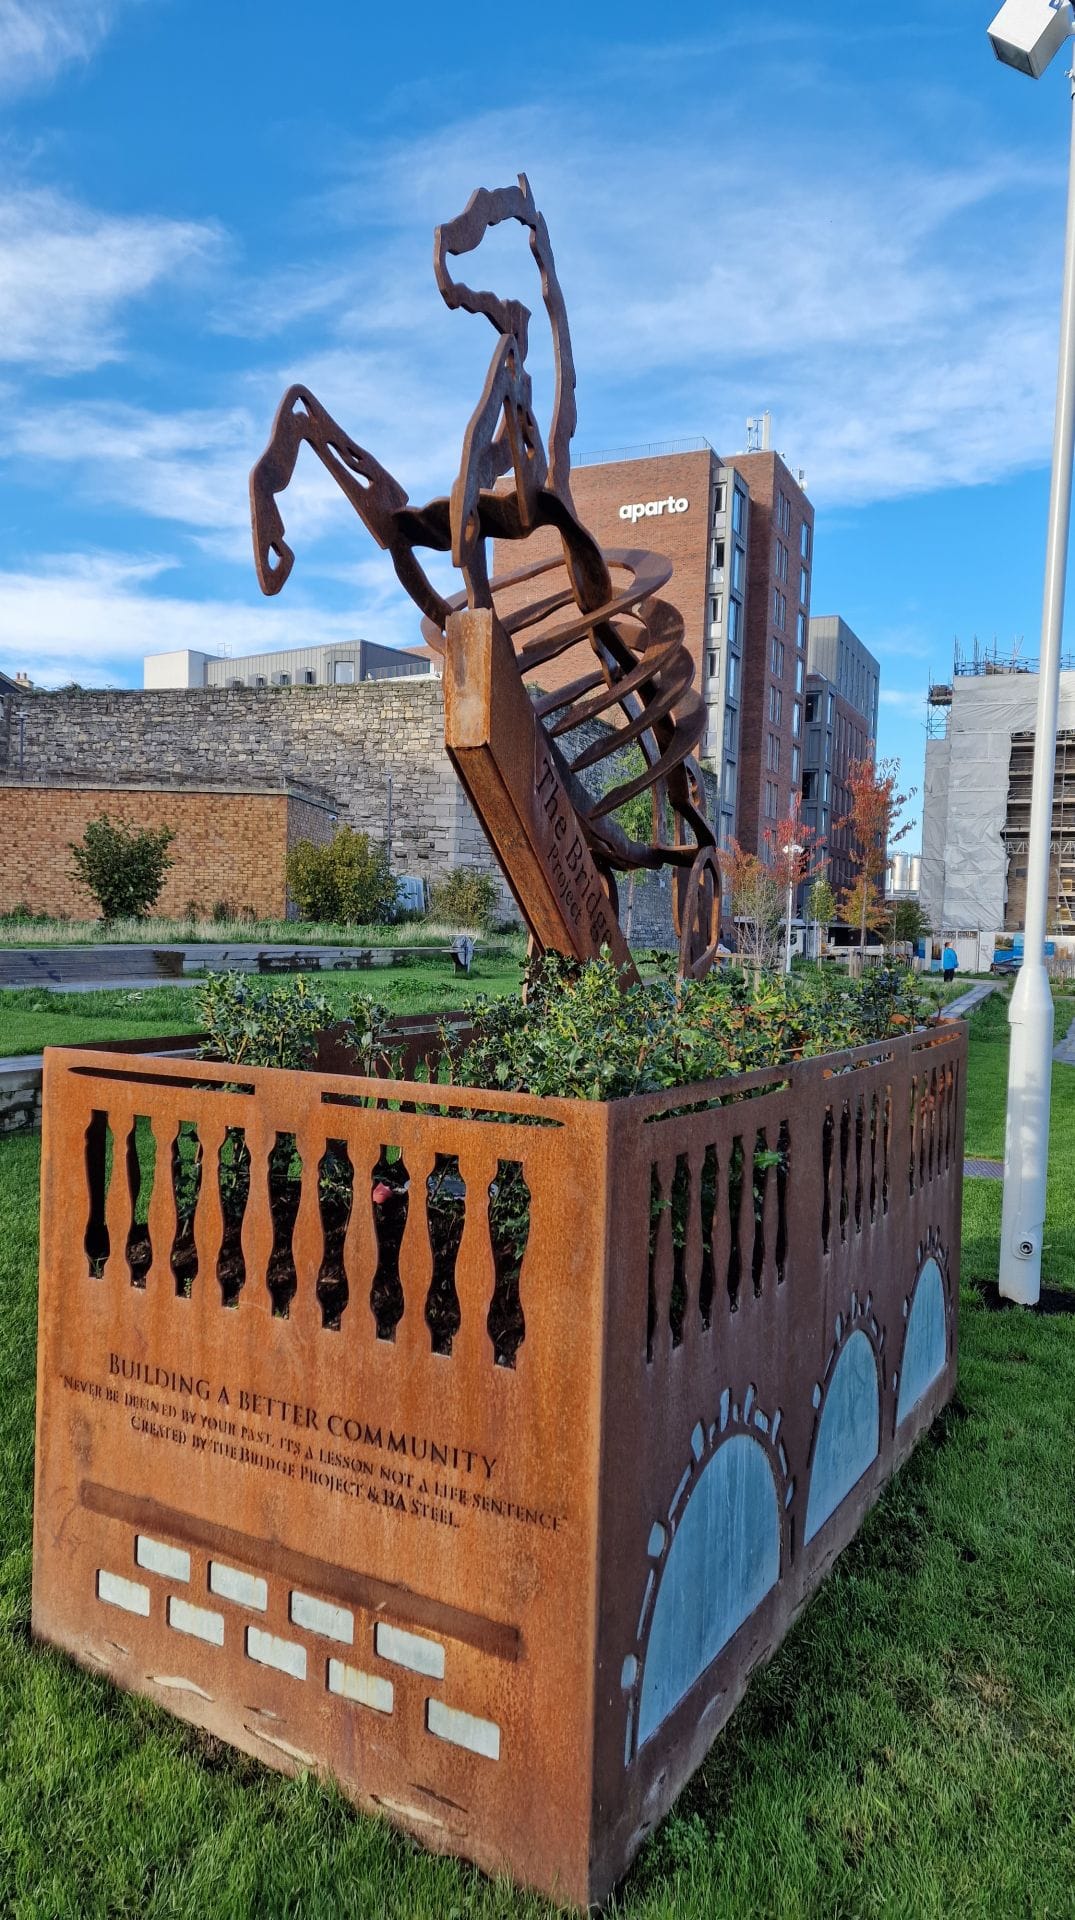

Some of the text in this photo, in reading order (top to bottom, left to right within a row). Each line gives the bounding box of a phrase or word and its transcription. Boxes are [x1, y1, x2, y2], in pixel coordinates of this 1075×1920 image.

[619, 495, 689, 523] aparto
[536, 757, 612, 943] The Bridge
[547, 843, 582, 926] Project
[106, 1387, 119, 1403] BE
[125, 1392, 177, 1418] DEFINED
[182, 1408, 197, 1424] BY
[200, 1414, 235, 1436] YOUR
[241, 1425, 275, 1448] PAST,
[304, 1445, 313, 1460] A
[320, 1447, 374, 1476] LESSON
[380, 1464, 414, 1488] NOT
[418, 1478, 428, 1493] A
[435, 1481, 467, 1507] LIFE
[109, 1352, 497, 1479] BUILDING A BETTER COMMUNITY
[131, 1415, 187, 1445] CREATED
[192, 1434, 207, 1450] BY
[210, 1439, 236, 1460] THE
[240, 1447, 295, 1479] BRIDGE
[301, 1463, 363, 1498] PROJECT
[367, 1485, 379, 1504] &
